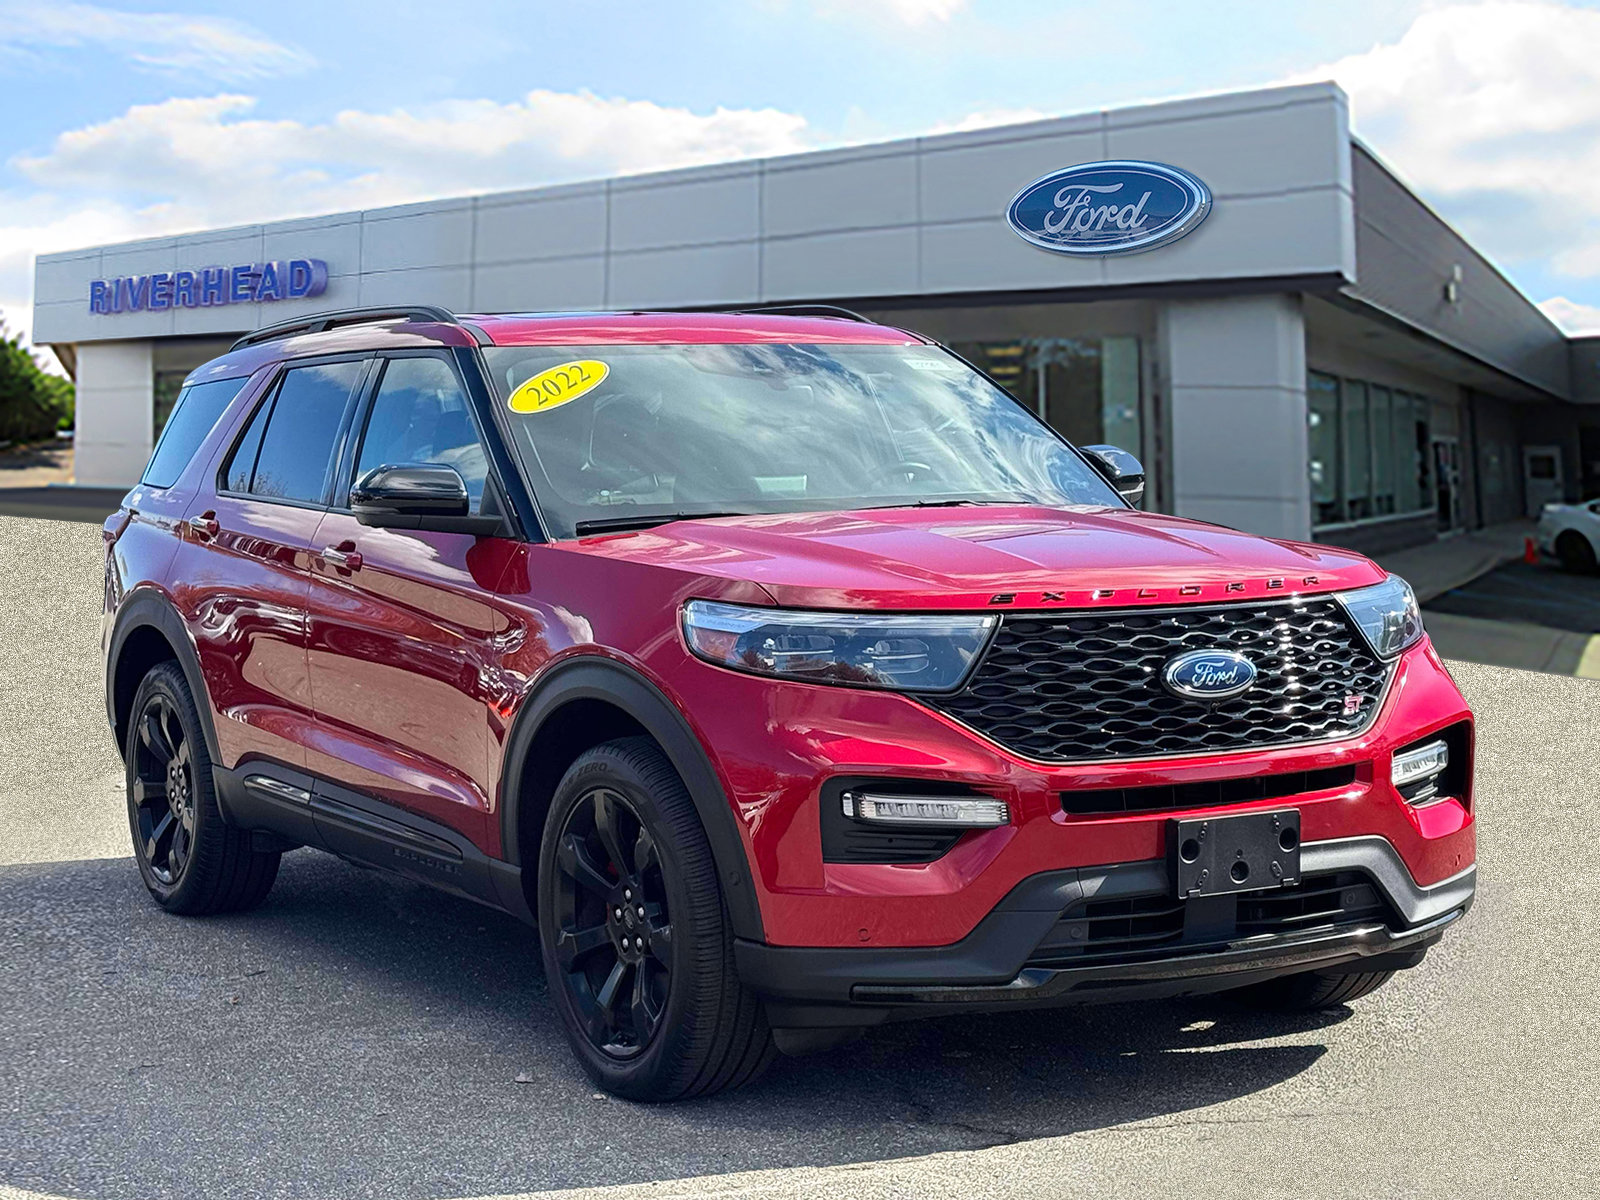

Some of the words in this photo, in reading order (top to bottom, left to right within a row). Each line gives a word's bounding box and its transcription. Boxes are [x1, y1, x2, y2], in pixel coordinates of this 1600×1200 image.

[1043, 182, 1152, 234] Ford
[89, 258, 325, 315] RIVERHEAD
[526, 365, 591, 406] 2022
[988, 576, 1320, 605] EXPLORER
[1191, 661, 1238, 687] Ford
